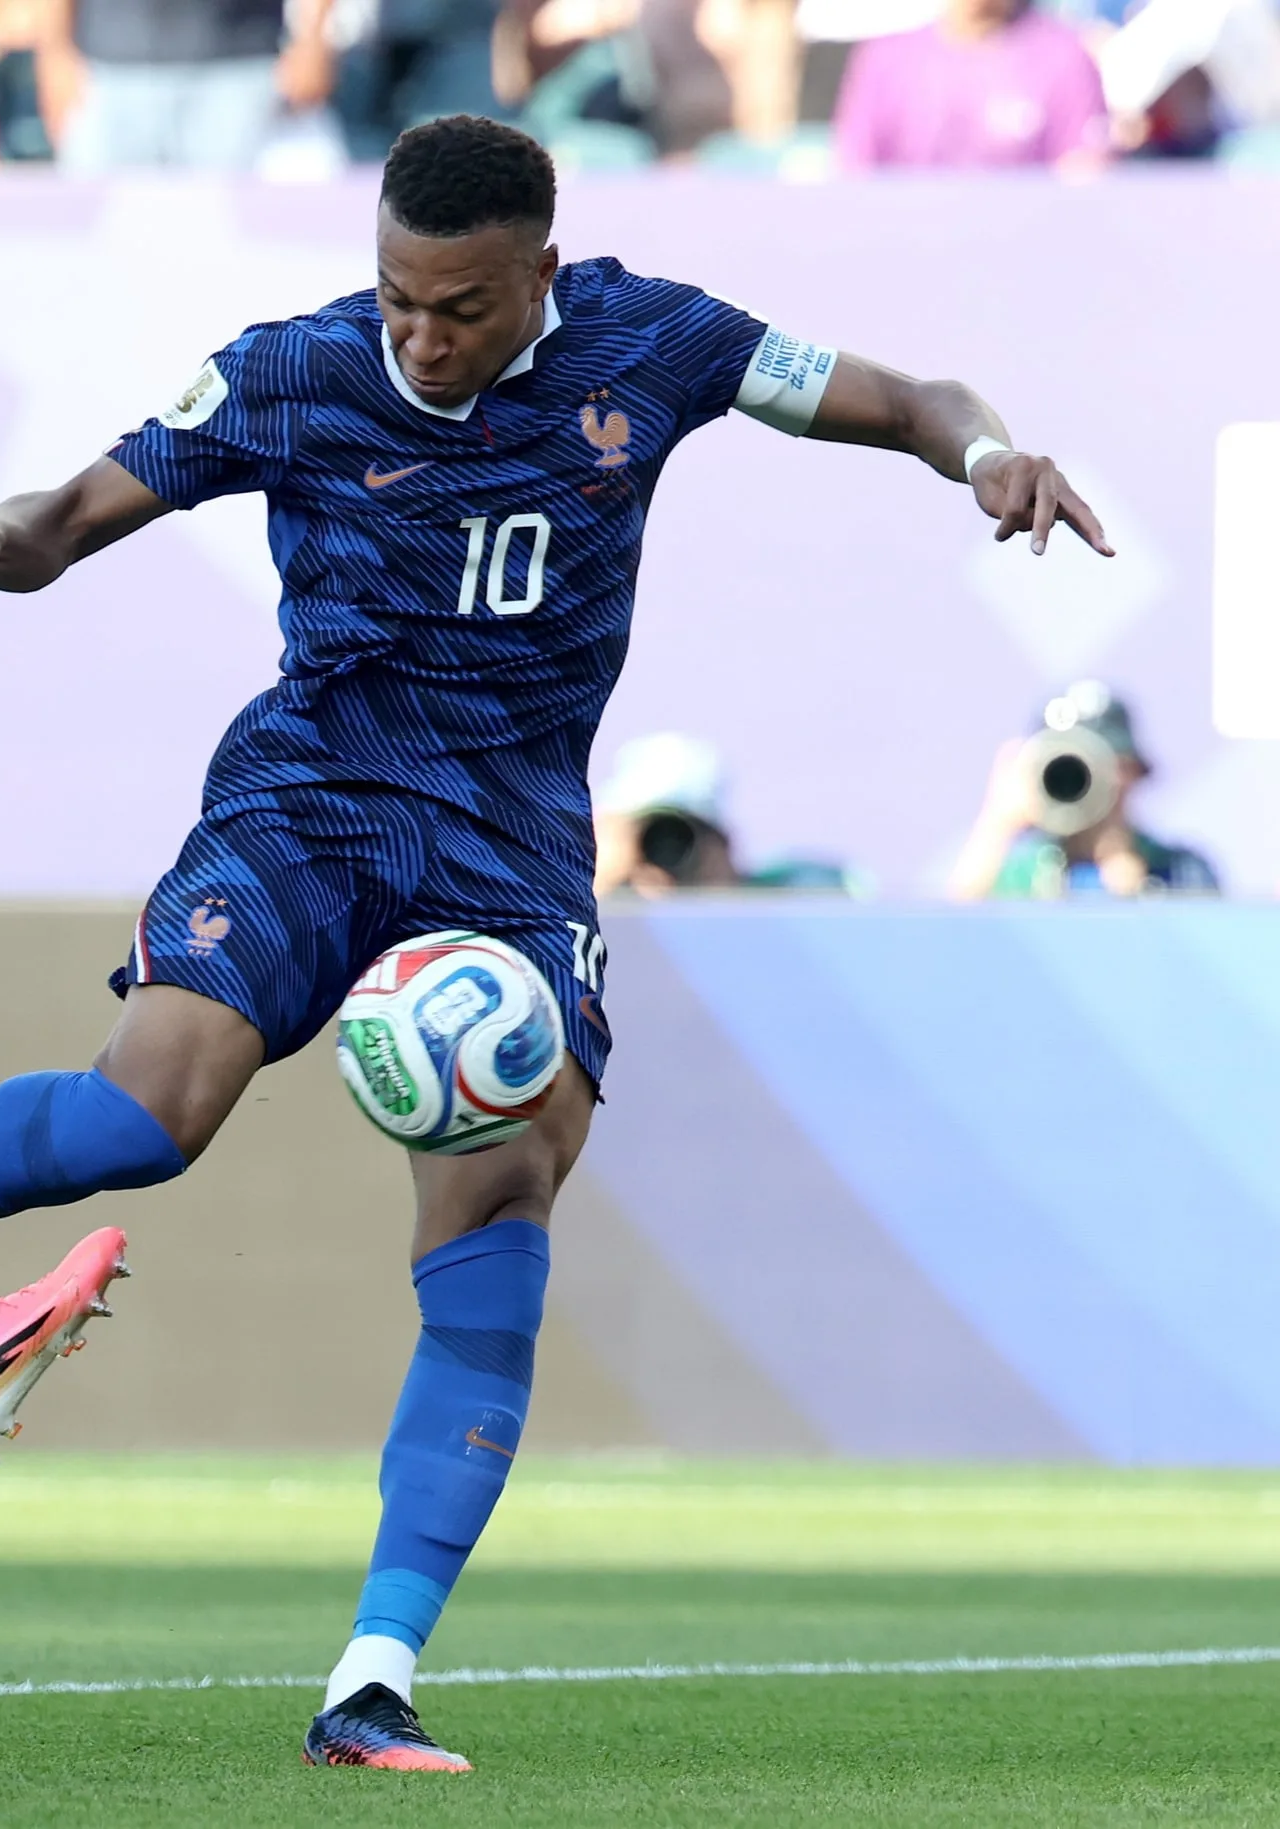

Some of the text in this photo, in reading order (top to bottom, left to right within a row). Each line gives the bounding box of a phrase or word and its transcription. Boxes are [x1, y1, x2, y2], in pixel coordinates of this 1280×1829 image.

[756, 328, 781, 375] FOOTBAL
[790, 364, 808, 390] the
[457, 513, 551, 615] 10
[376, 1029, 410, 1098] TRIONDA
